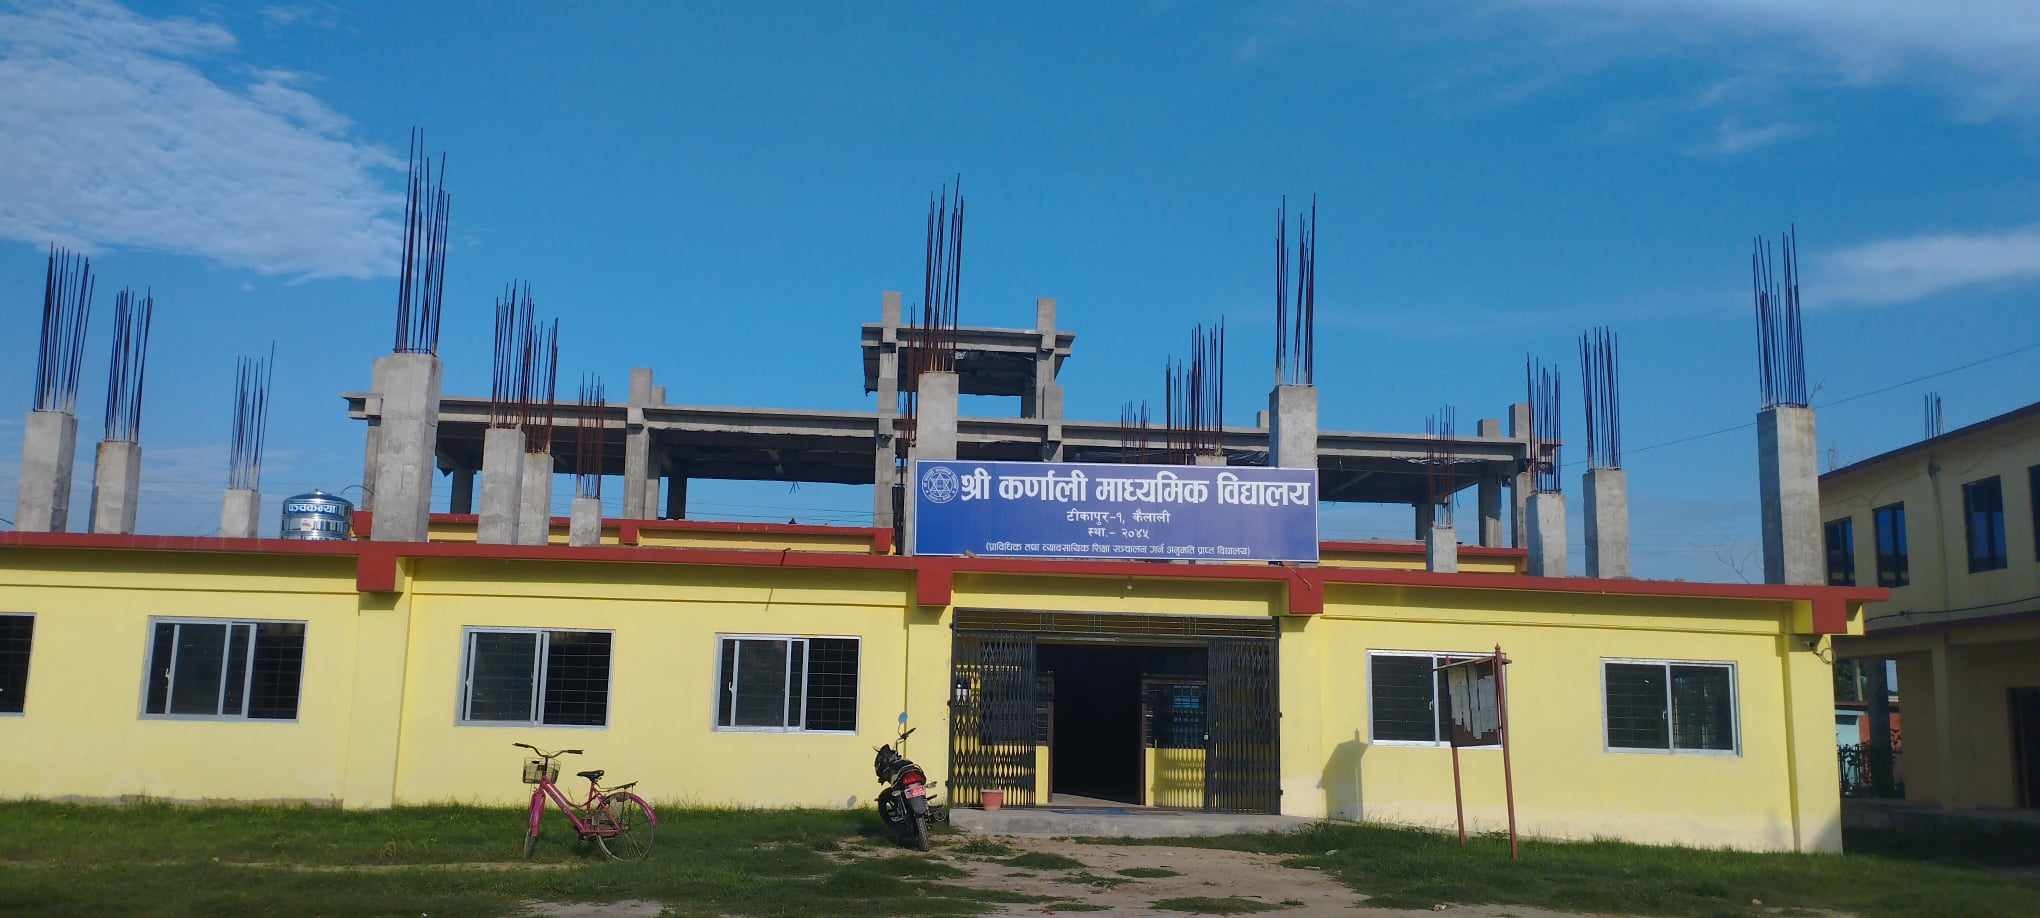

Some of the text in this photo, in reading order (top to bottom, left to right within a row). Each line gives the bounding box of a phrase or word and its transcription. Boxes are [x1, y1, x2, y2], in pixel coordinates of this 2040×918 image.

[960, 467, 992, 501] श्री
[998, 469, 1088, 503] कर्णाली
[1095, 470, 1210, 504] माध्यमिक
[1216, 471, 1311, 507] विद्यालय
[1131, 508, 1171, 523] कैलाली
[1121, 528, 1150, 539] २०४५
[1024, 543, 1040, 552] तथा
[1091, 543, 1110, 553] शिक्षा
